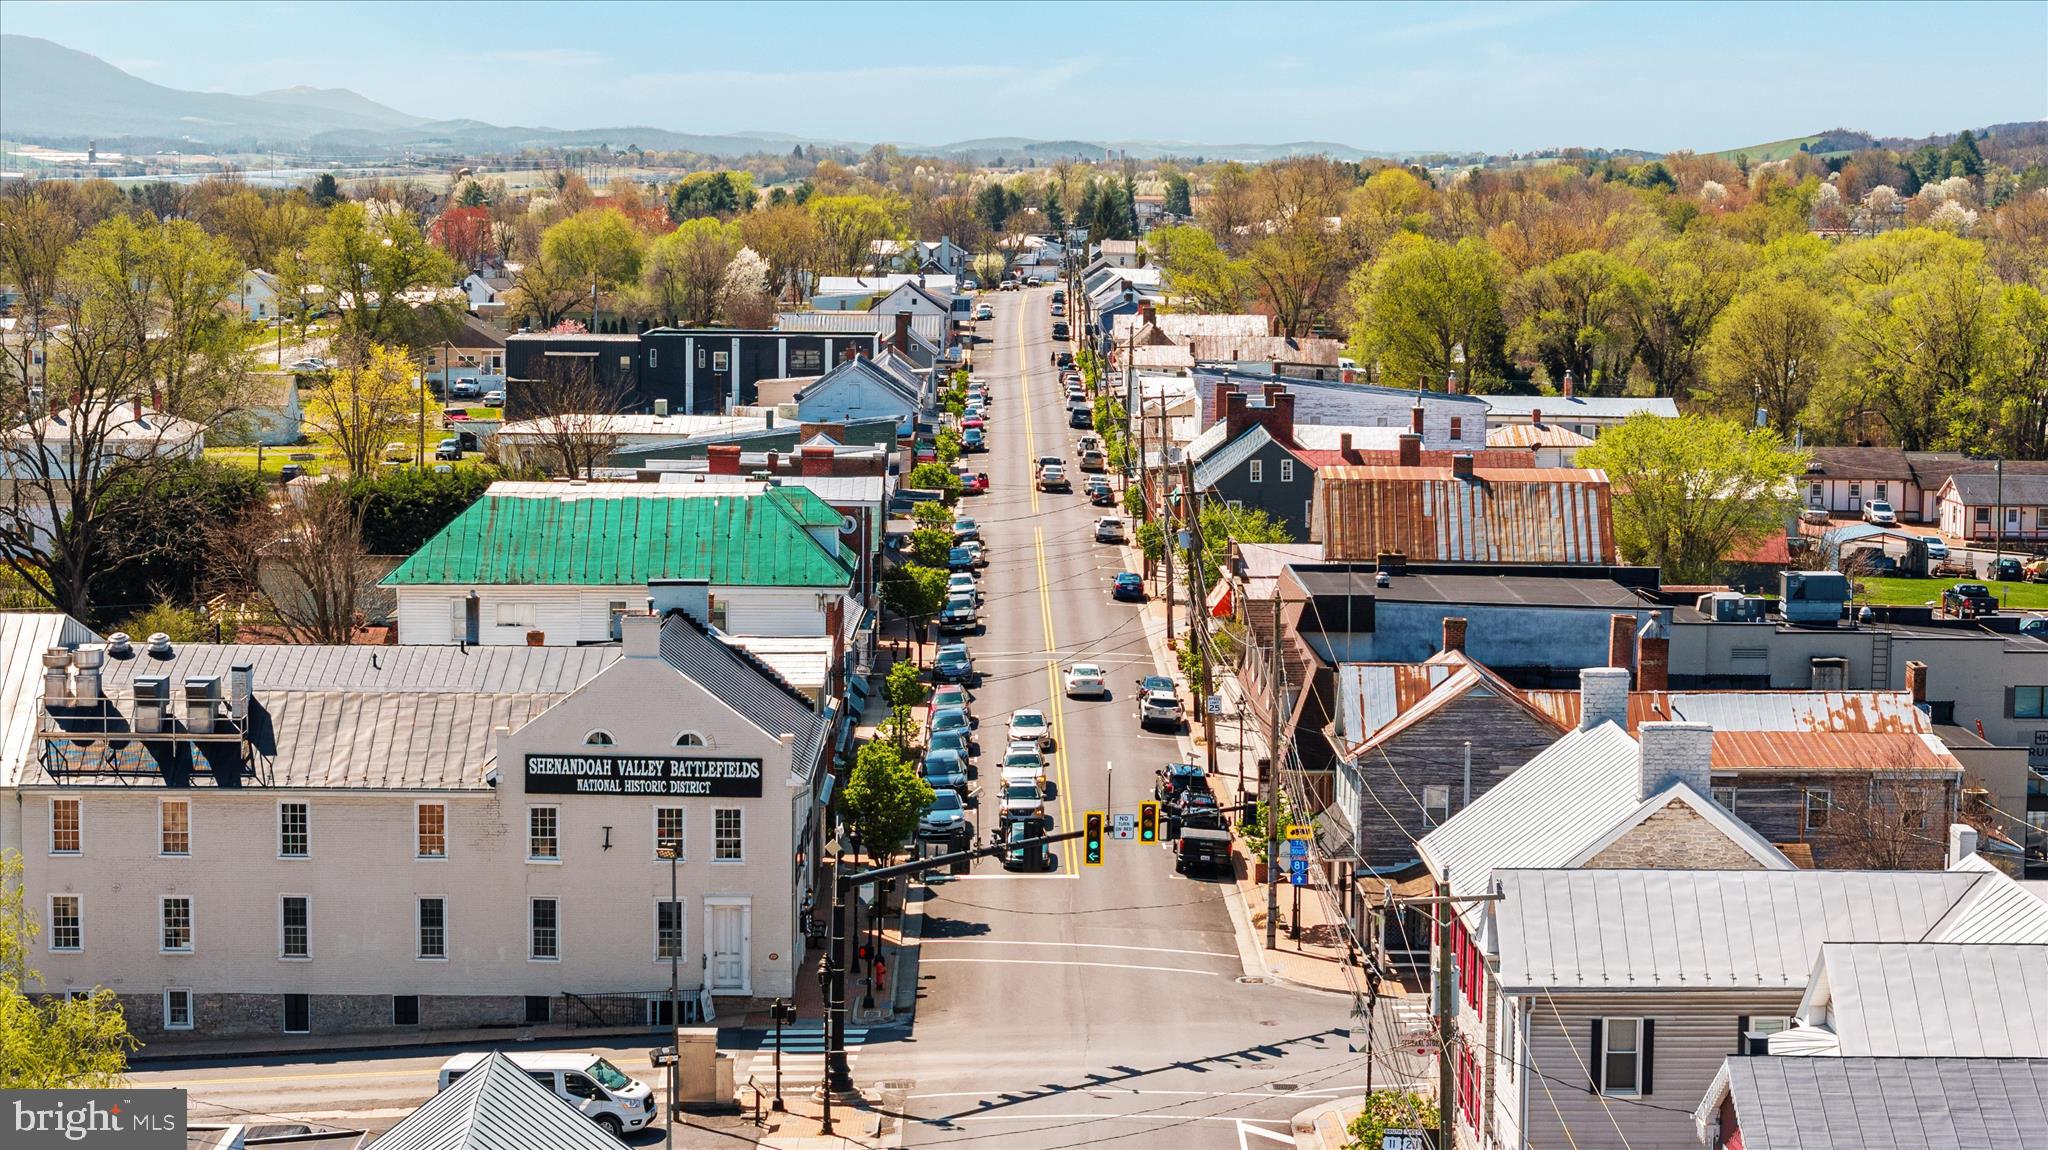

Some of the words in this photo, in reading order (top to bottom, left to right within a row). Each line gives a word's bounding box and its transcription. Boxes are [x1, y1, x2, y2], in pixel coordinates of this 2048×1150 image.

[528, 757, 612, 776] SHENANDOAH
[617, 759, 664, 777] VALLEY
[670, 760, 760, 779] BATTLEFIELDS
[577, 778, 622, 792] NATIONAL
[624, 779, 667, 793] HISTORIC
[669, 780, 712, 794] DISTRICT
[1294, 861, 1304, 870] 81
[1389, 1139, 1396, 1148] 11
